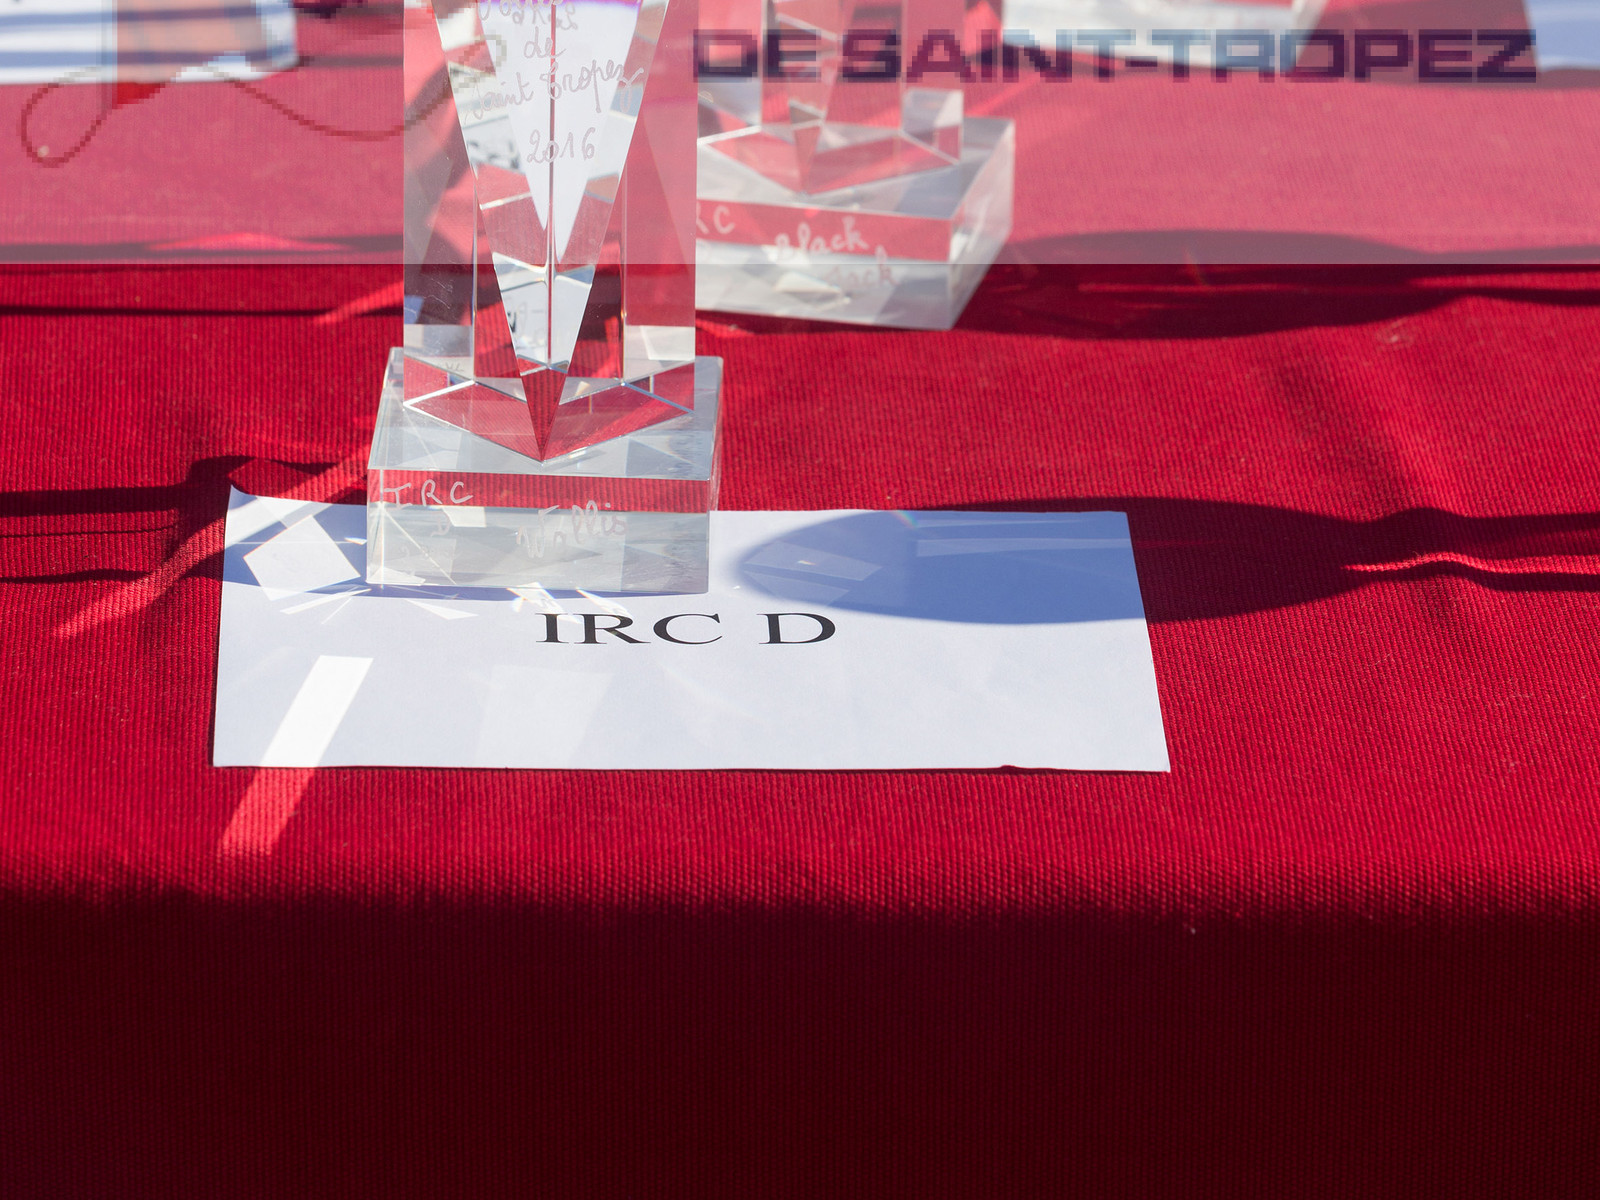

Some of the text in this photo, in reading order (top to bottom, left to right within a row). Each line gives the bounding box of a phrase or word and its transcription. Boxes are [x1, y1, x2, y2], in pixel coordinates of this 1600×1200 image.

[526, 126, 596, 164] 2016
[383, 479, 474, 511] IRC
[535, 613, 836, 644] IRC D
